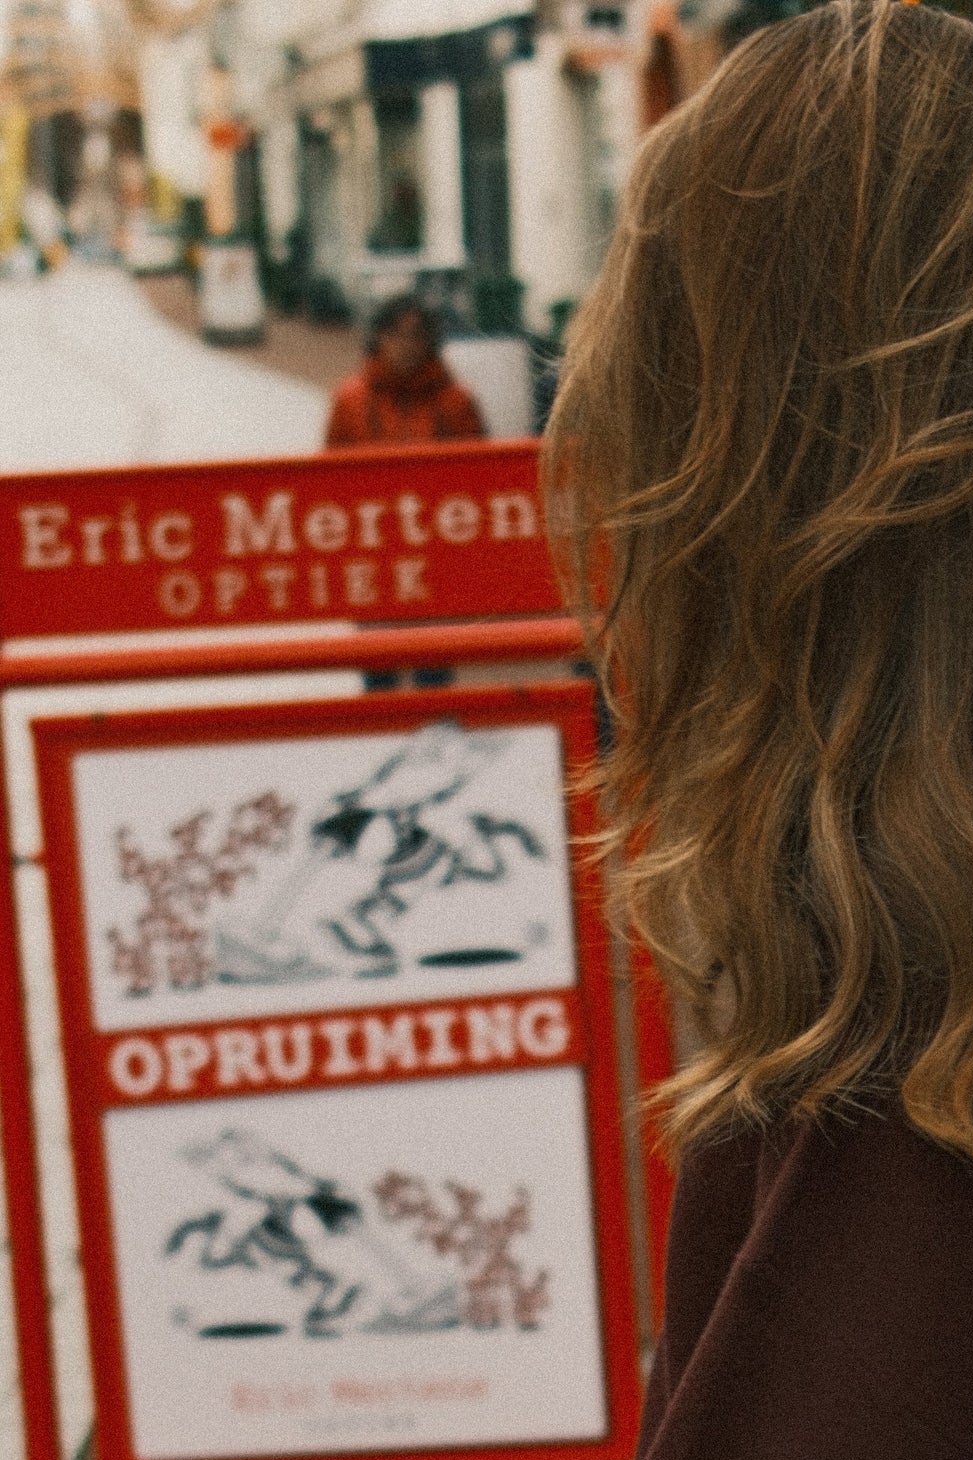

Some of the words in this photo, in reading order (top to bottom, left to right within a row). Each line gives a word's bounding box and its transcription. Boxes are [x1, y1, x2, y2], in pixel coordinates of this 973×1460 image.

[20, 503, 194, 568] Eric
[221, 492, 574, 556] Merten
[159, 557, 430, 616] OPTIEK
[109, 1000, 570, 1096] OPRUIMING
